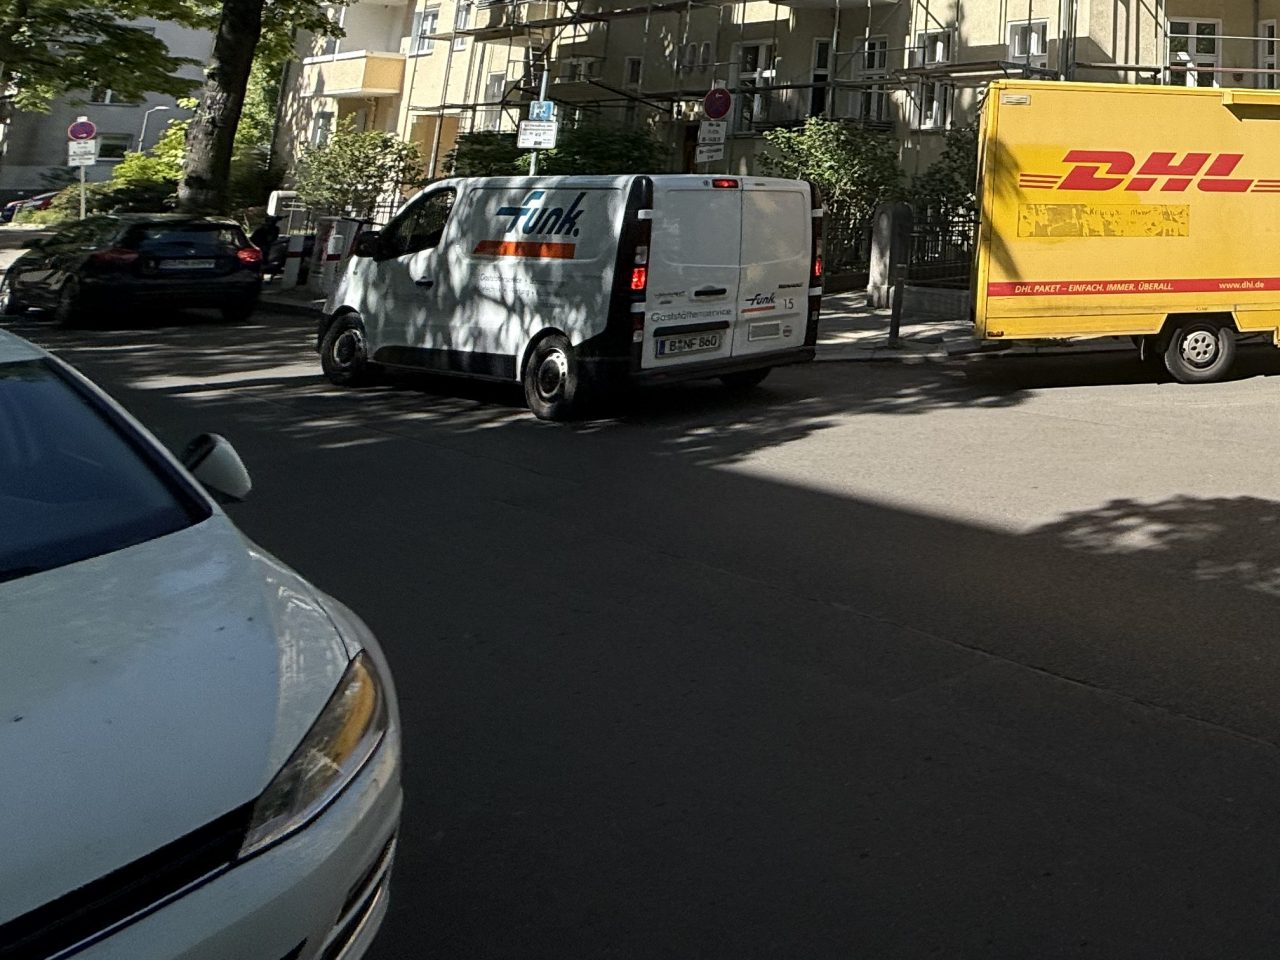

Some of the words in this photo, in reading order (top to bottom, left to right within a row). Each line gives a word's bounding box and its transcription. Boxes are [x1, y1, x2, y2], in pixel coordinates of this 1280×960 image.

[1056, 150, 1254, 192] DHL
[1015, 285, 1032, 293] DHL
[1034, 284, 1061, 293] PAKET
[1068, 283, 1105, 292] EINFACH.
[1106, 283, 1136, 291] IMMER.
[1138, 281, 1174, 290] ÜBERALL.
[1218, 280, 1265, 289] www.dhl.de
